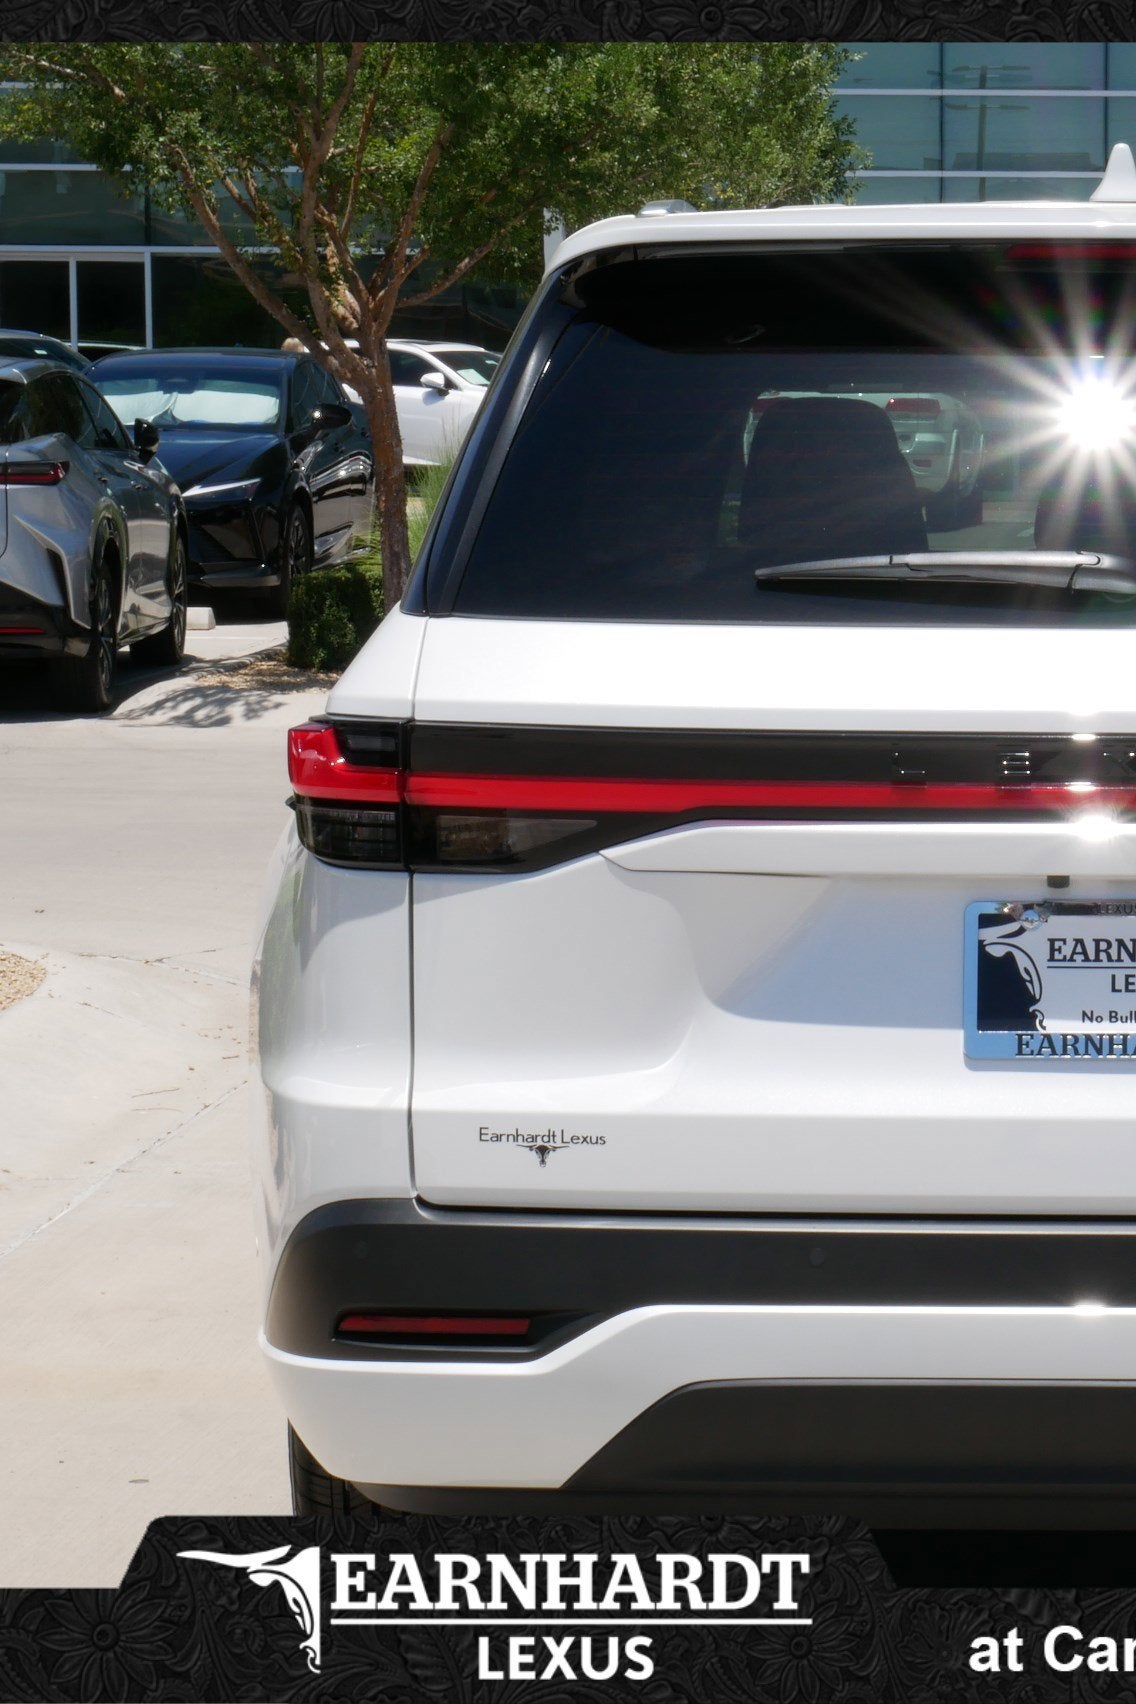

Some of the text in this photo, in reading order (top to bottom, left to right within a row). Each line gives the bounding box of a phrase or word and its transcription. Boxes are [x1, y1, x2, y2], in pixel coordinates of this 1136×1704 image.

[1081, 1010, 1104, 1023] No
[479, 1127, 607, 1145] Earnhardt Lexus
